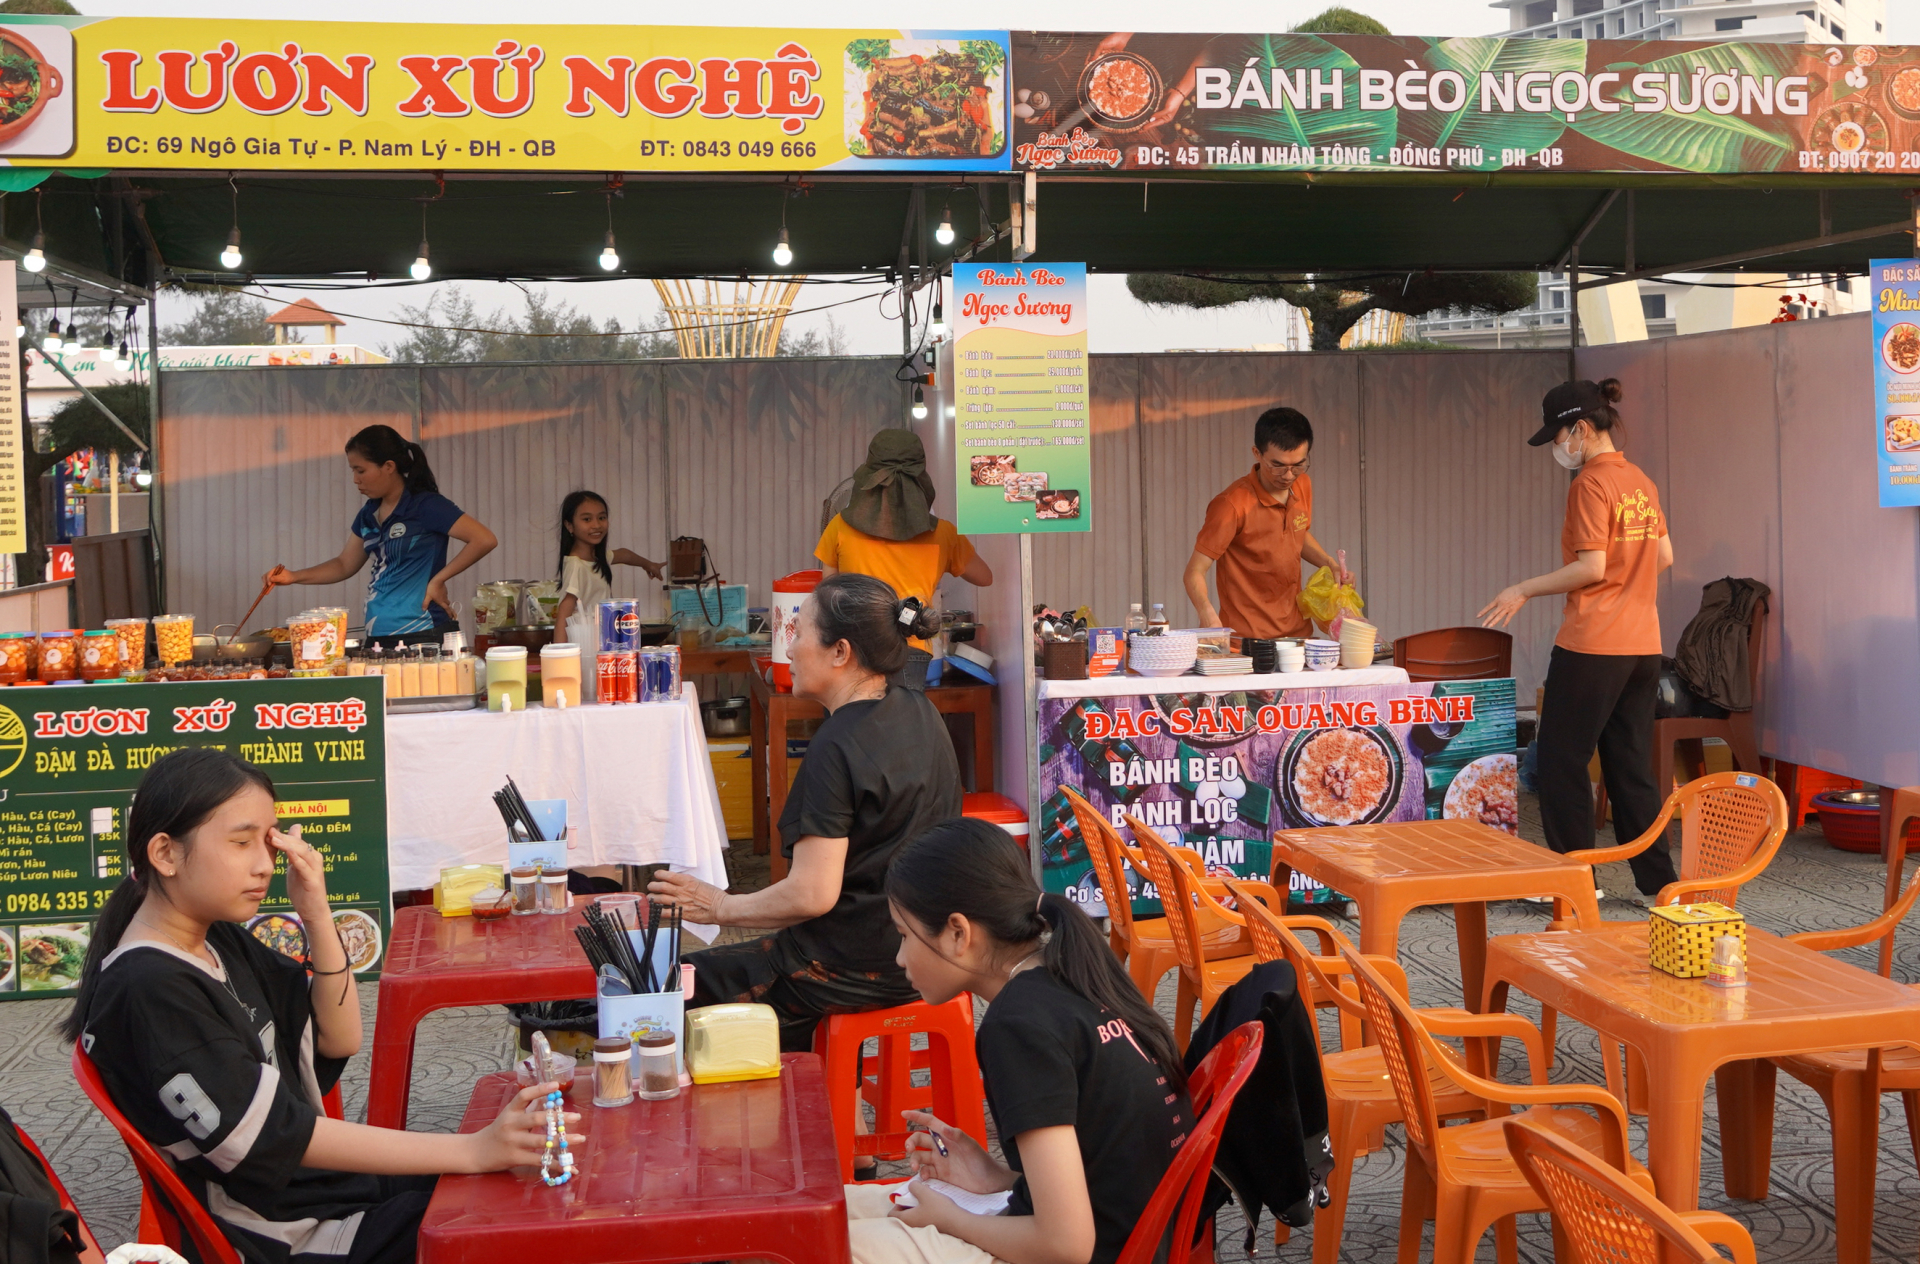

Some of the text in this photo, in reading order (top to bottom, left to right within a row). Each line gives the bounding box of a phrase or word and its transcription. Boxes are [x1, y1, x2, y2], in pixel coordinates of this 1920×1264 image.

[101, 39, 823, 136] LƯƠN XỨ NGHỆ
[1195, 57, 1809, 123] BÁNH BÈO NGỌC SƯƠNG
[107, 136, 149, 154] ĐC:
[157, 137, 183, 155] 69
[191, 136, 236, 160] Ngô
[243, 138, 281, 156] Gia
[289, 138, 318, 161] Tự
[339, 139, 358, 157] P.
[364, 139, 413, 157] Nam
[421, 139, 447, 162] Lý
[468, 141, 502, 158] ĐH
[523, 142, 556, 158] QB
[641, 141, 817, 159] ĐT: 0843 049 666
[1037, 132, 1069, 148] Bánh
[1017, 142, 1122, 169] Ngọc Sương
[1137, 147, 1170, 165] ĐC:
[1175, 147, 1199, 165] 45
[1206, 140, 1255, 165] TRẦN
[1262, 142, 1315, 165] NHÂN
[1321, 143, 1370, 165] TÔNG
[1389, 141, 1441, 166] ĐỒNG
[1447, 144, 1483, 166] PHÚ
[1501, 148, 1527, 166] ĐH
[1798, 150, 1920, 170] ĐT: 0907 20 20
[977, 267, 1066, 287] Bánh Bèo
[1882, 264, 1920, 285] ĐẶC SẢ
[962, 292, 1072, 325] Ngọc Sương
[43, 351, 97, 377] Kem
[33, 697, 367, 738] LƯƠN XỨ NGHỆ
[1084, 708, 1160, 740] ĐẶC
[1170, 695, 1246, 735] SẢN
[1256, 690, 1378, 735] QUẢNG
[35, 747, 77, 779] ĐẬM
[87, 742, 116, 772] ĐÀ
[240, 736, 304, 764] THÀNH
[314, 740, 366, 761] VINH
[1109, 752, 1238, 787] BÁNH BÈO
[1, 809, 76, 822] Hàu, Cá (Cay)
[289, 803, 305, 815] HÀ
[308, 802, 327, 816] NỘI
[1111, 797, 1238, 829] BÁNH LỌC
[8, 821, 83, 834] Hàu, Cá (Cay)
[301, 822, 351, 835] HÁO ĐÊM
[7, 832, 121, 846] Hàu, Cá, Lươn 35K
[0, 855, 122, 870] ơn, Hàu 5K
[13, 847, 33, 857] rán
[275, 856, 284, 865] ối
[343, 852, 358, 862] nồi
[21, 871, 49, 881] Lươn
[52, 869, 78, 880] Niêu
[107, 867, 122, 877] 0K
[1065, 886, 1089, 903] Cơ
[1288, 867, 1326, 891] ÔNG
[7, 892, 51, 913] 0984
[56, 891, 88, 911] 335
[346, 892, 360, 902] giá
